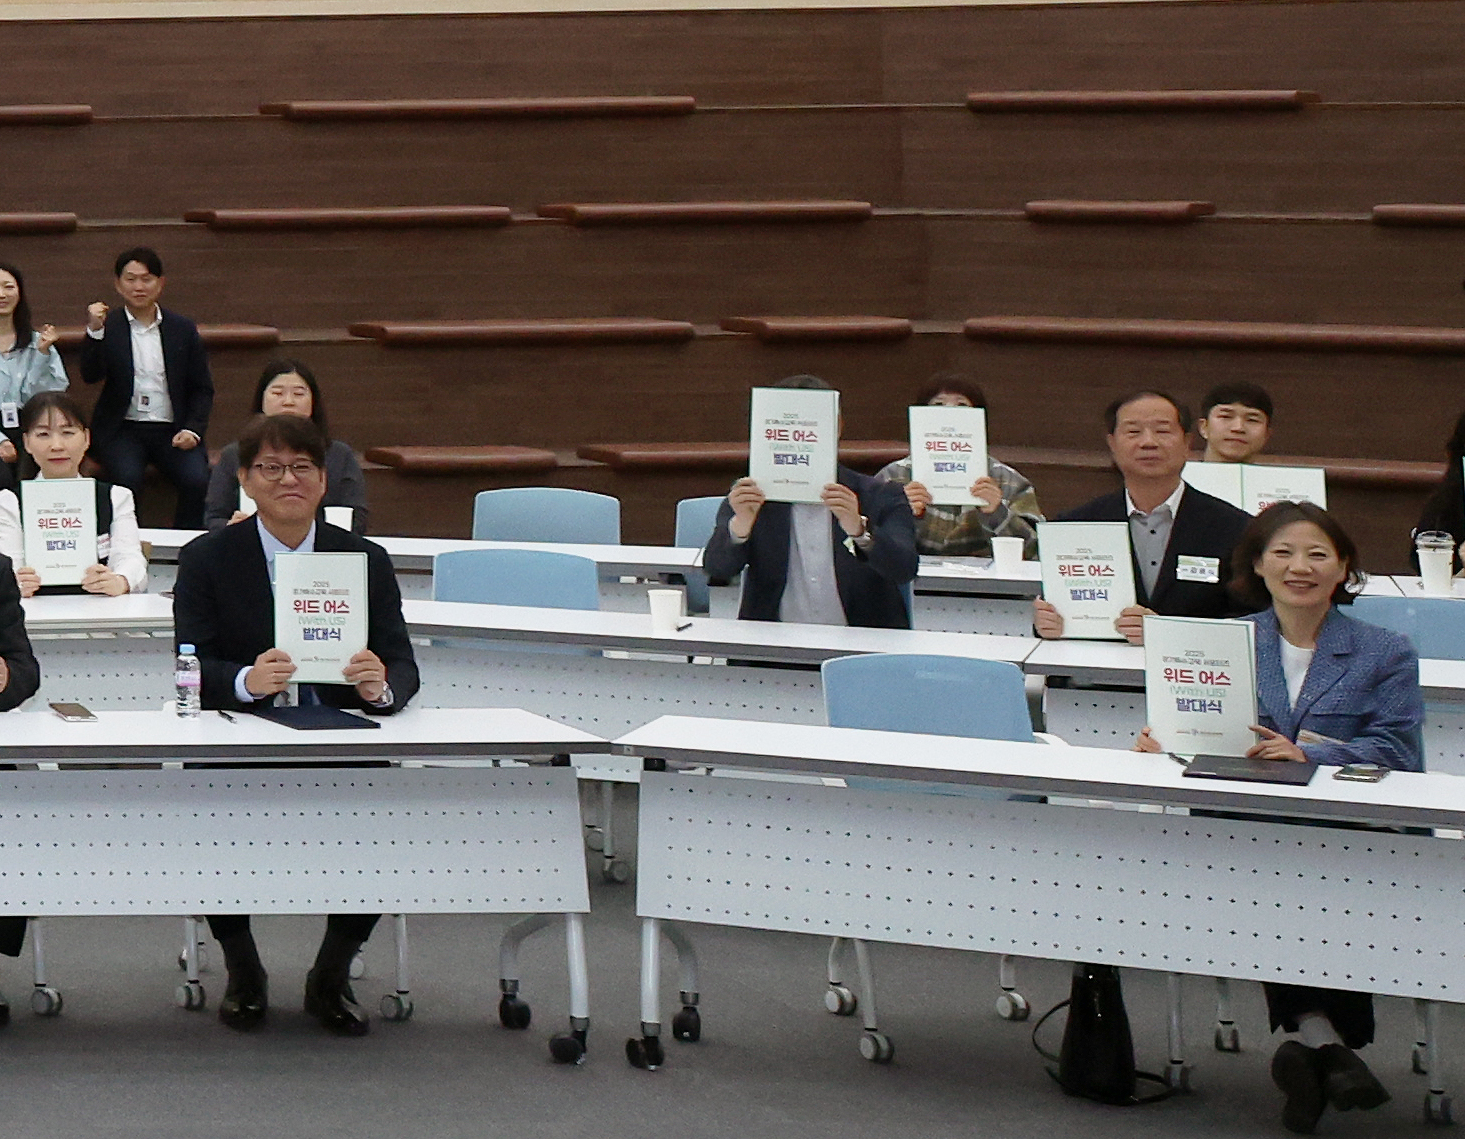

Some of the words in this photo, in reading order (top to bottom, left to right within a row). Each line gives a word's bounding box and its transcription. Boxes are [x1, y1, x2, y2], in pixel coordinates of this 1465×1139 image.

[293, 599, 320, 614] 위드
[323, 599, 350, 615] 어스
[302, 627, 341, 642] 발대식
[1163, 667, 1195, 684] 위드
[1198, 670, 1232, 686] 어스
[1175, 697, 1223, 715] 발대식
